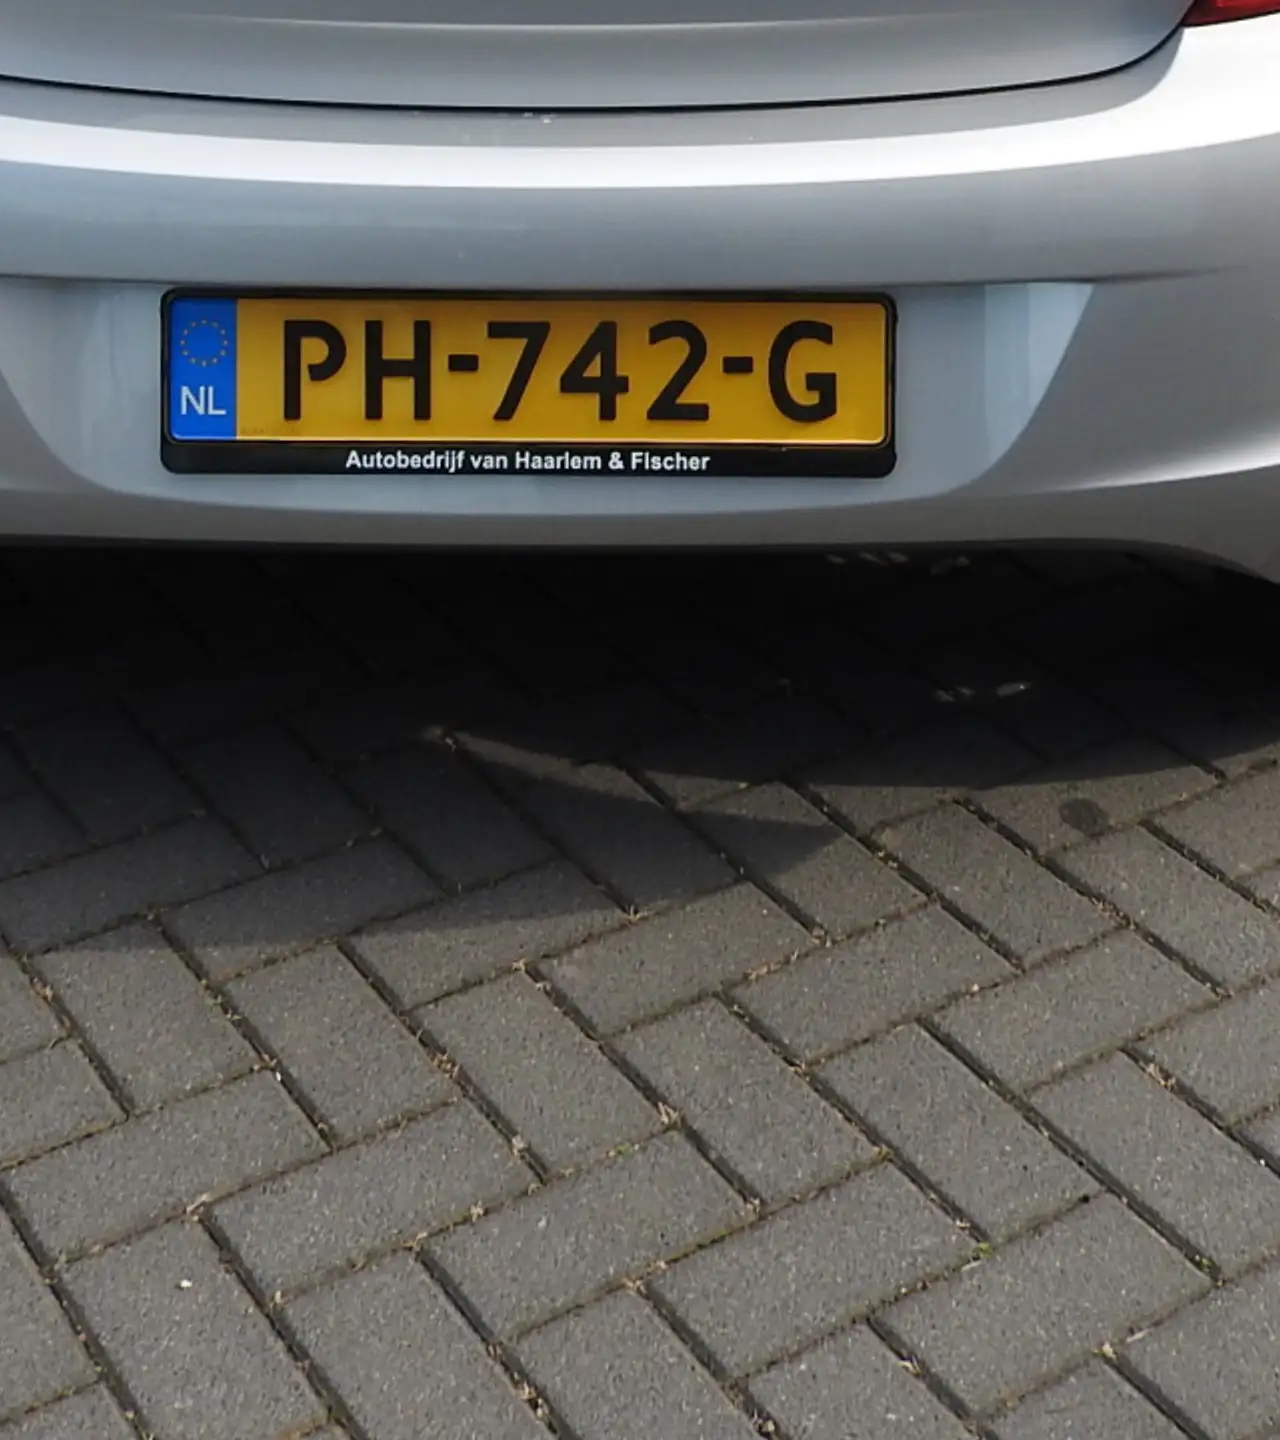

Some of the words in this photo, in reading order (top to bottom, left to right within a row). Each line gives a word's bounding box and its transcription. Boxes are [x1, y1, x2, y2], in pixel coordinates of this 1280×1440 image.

[180, 386, 226, 417] NL
[283, 320, 837, 423] PH-742-G
[345, 450, 464, 473] Autobedrijf
[470, 455, 508, 470] van
[516, 452, 602, 471] Haarlem
[608, 453, 624, 471] &
[631, 453, 710, 471] Fischer
